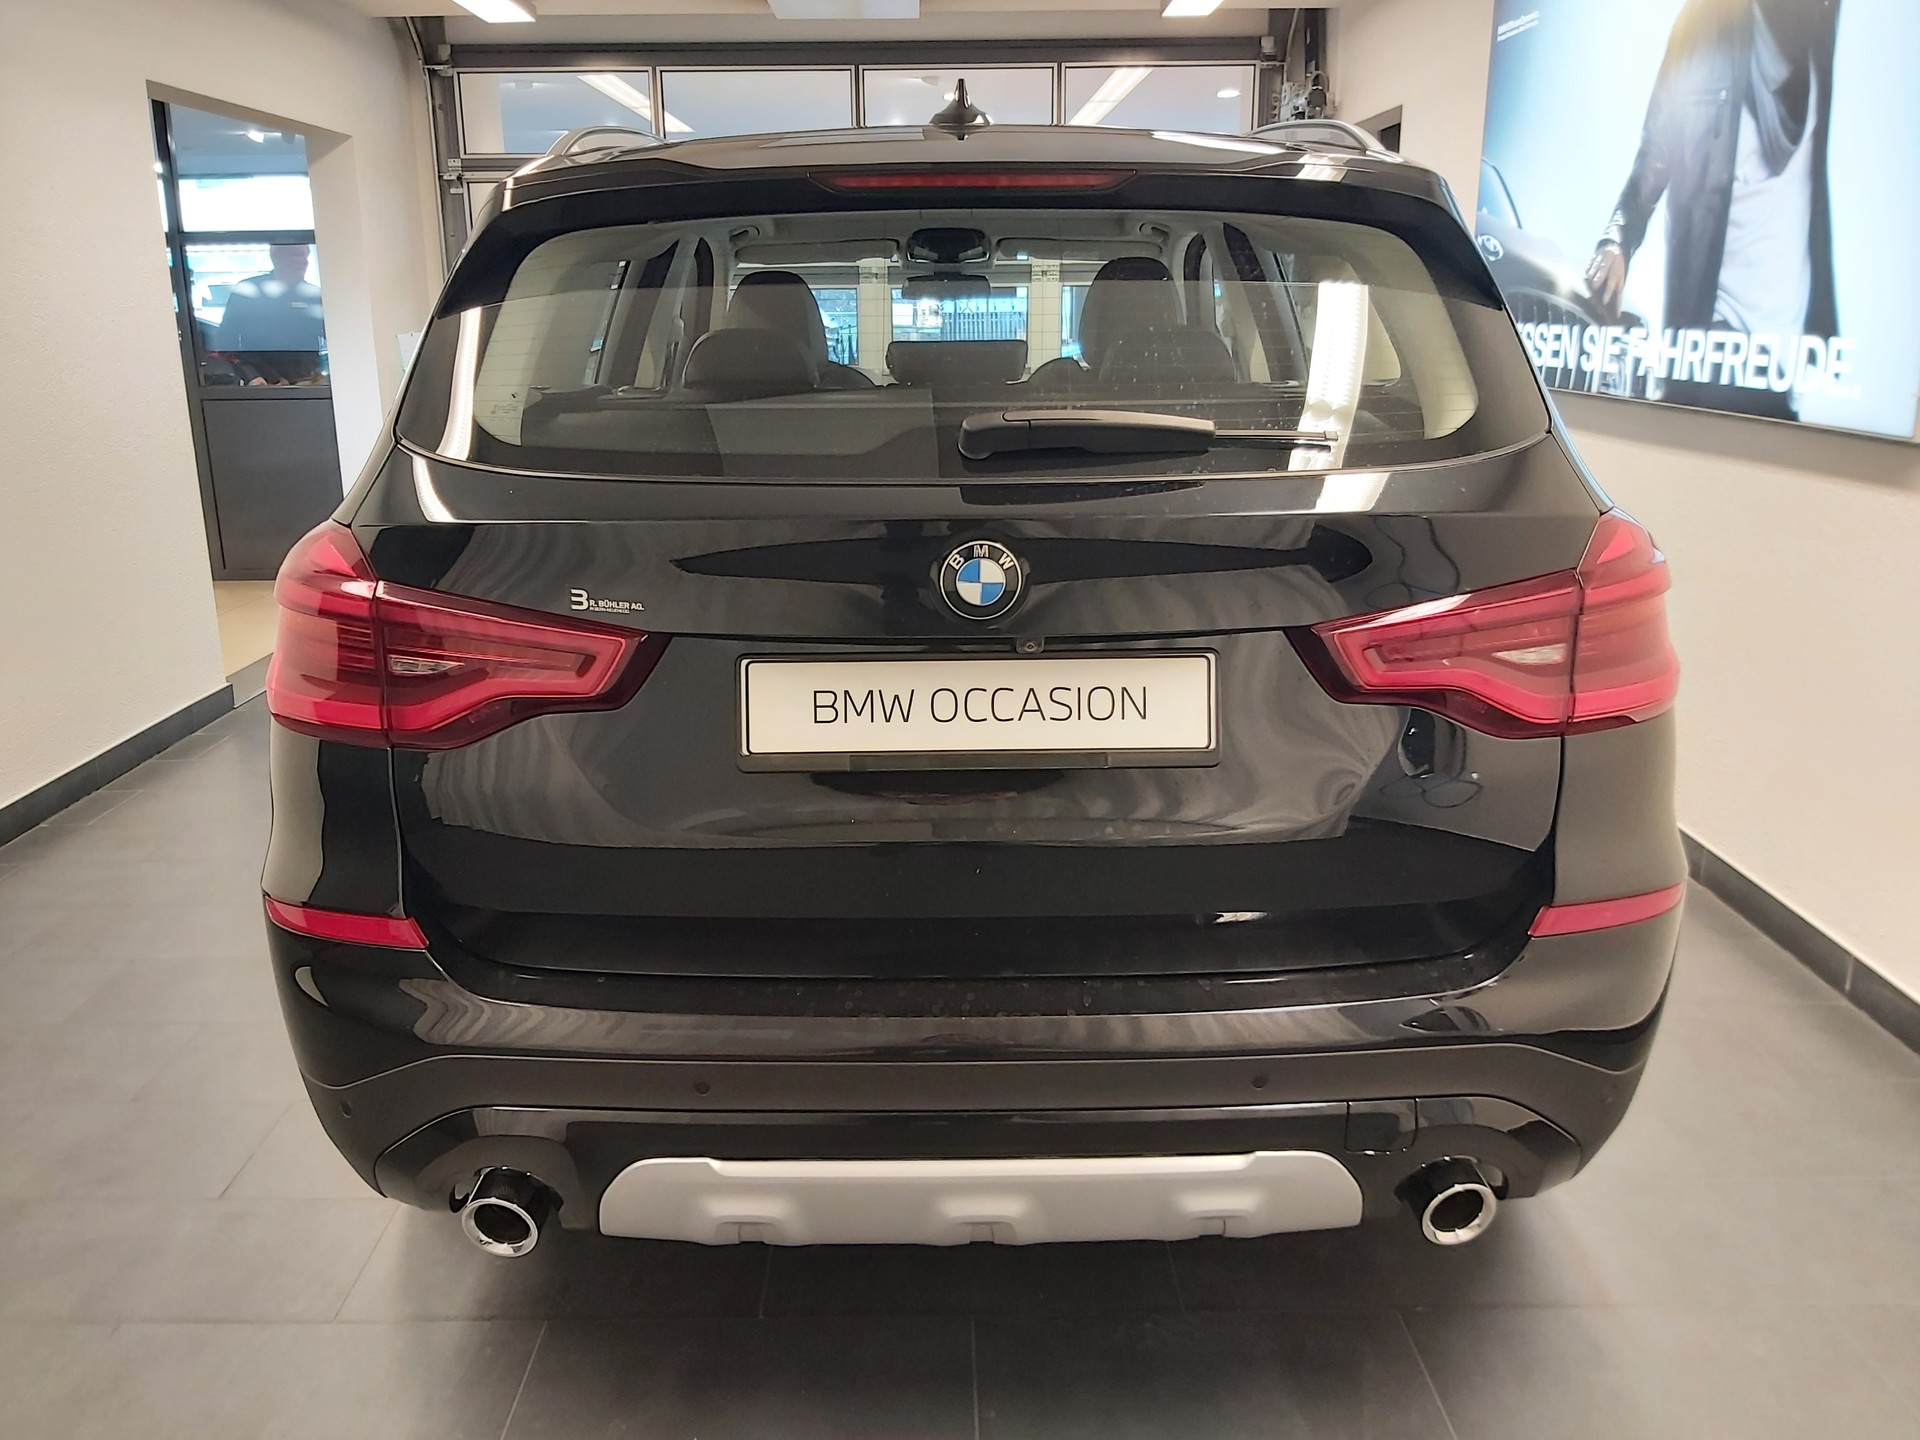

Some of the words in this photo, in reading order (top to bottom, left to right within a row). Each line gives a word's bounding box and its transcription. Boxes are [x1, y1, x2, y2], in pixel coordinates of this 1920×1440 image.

[1580, 324, 1625, 373] SIE
[948, 544, 1015, 571] BMW
[598, 599, 630, 609] BÜHLER
[812, 689, 915, 724] BMW
[929, 685, 1148, 723] OCCASION
